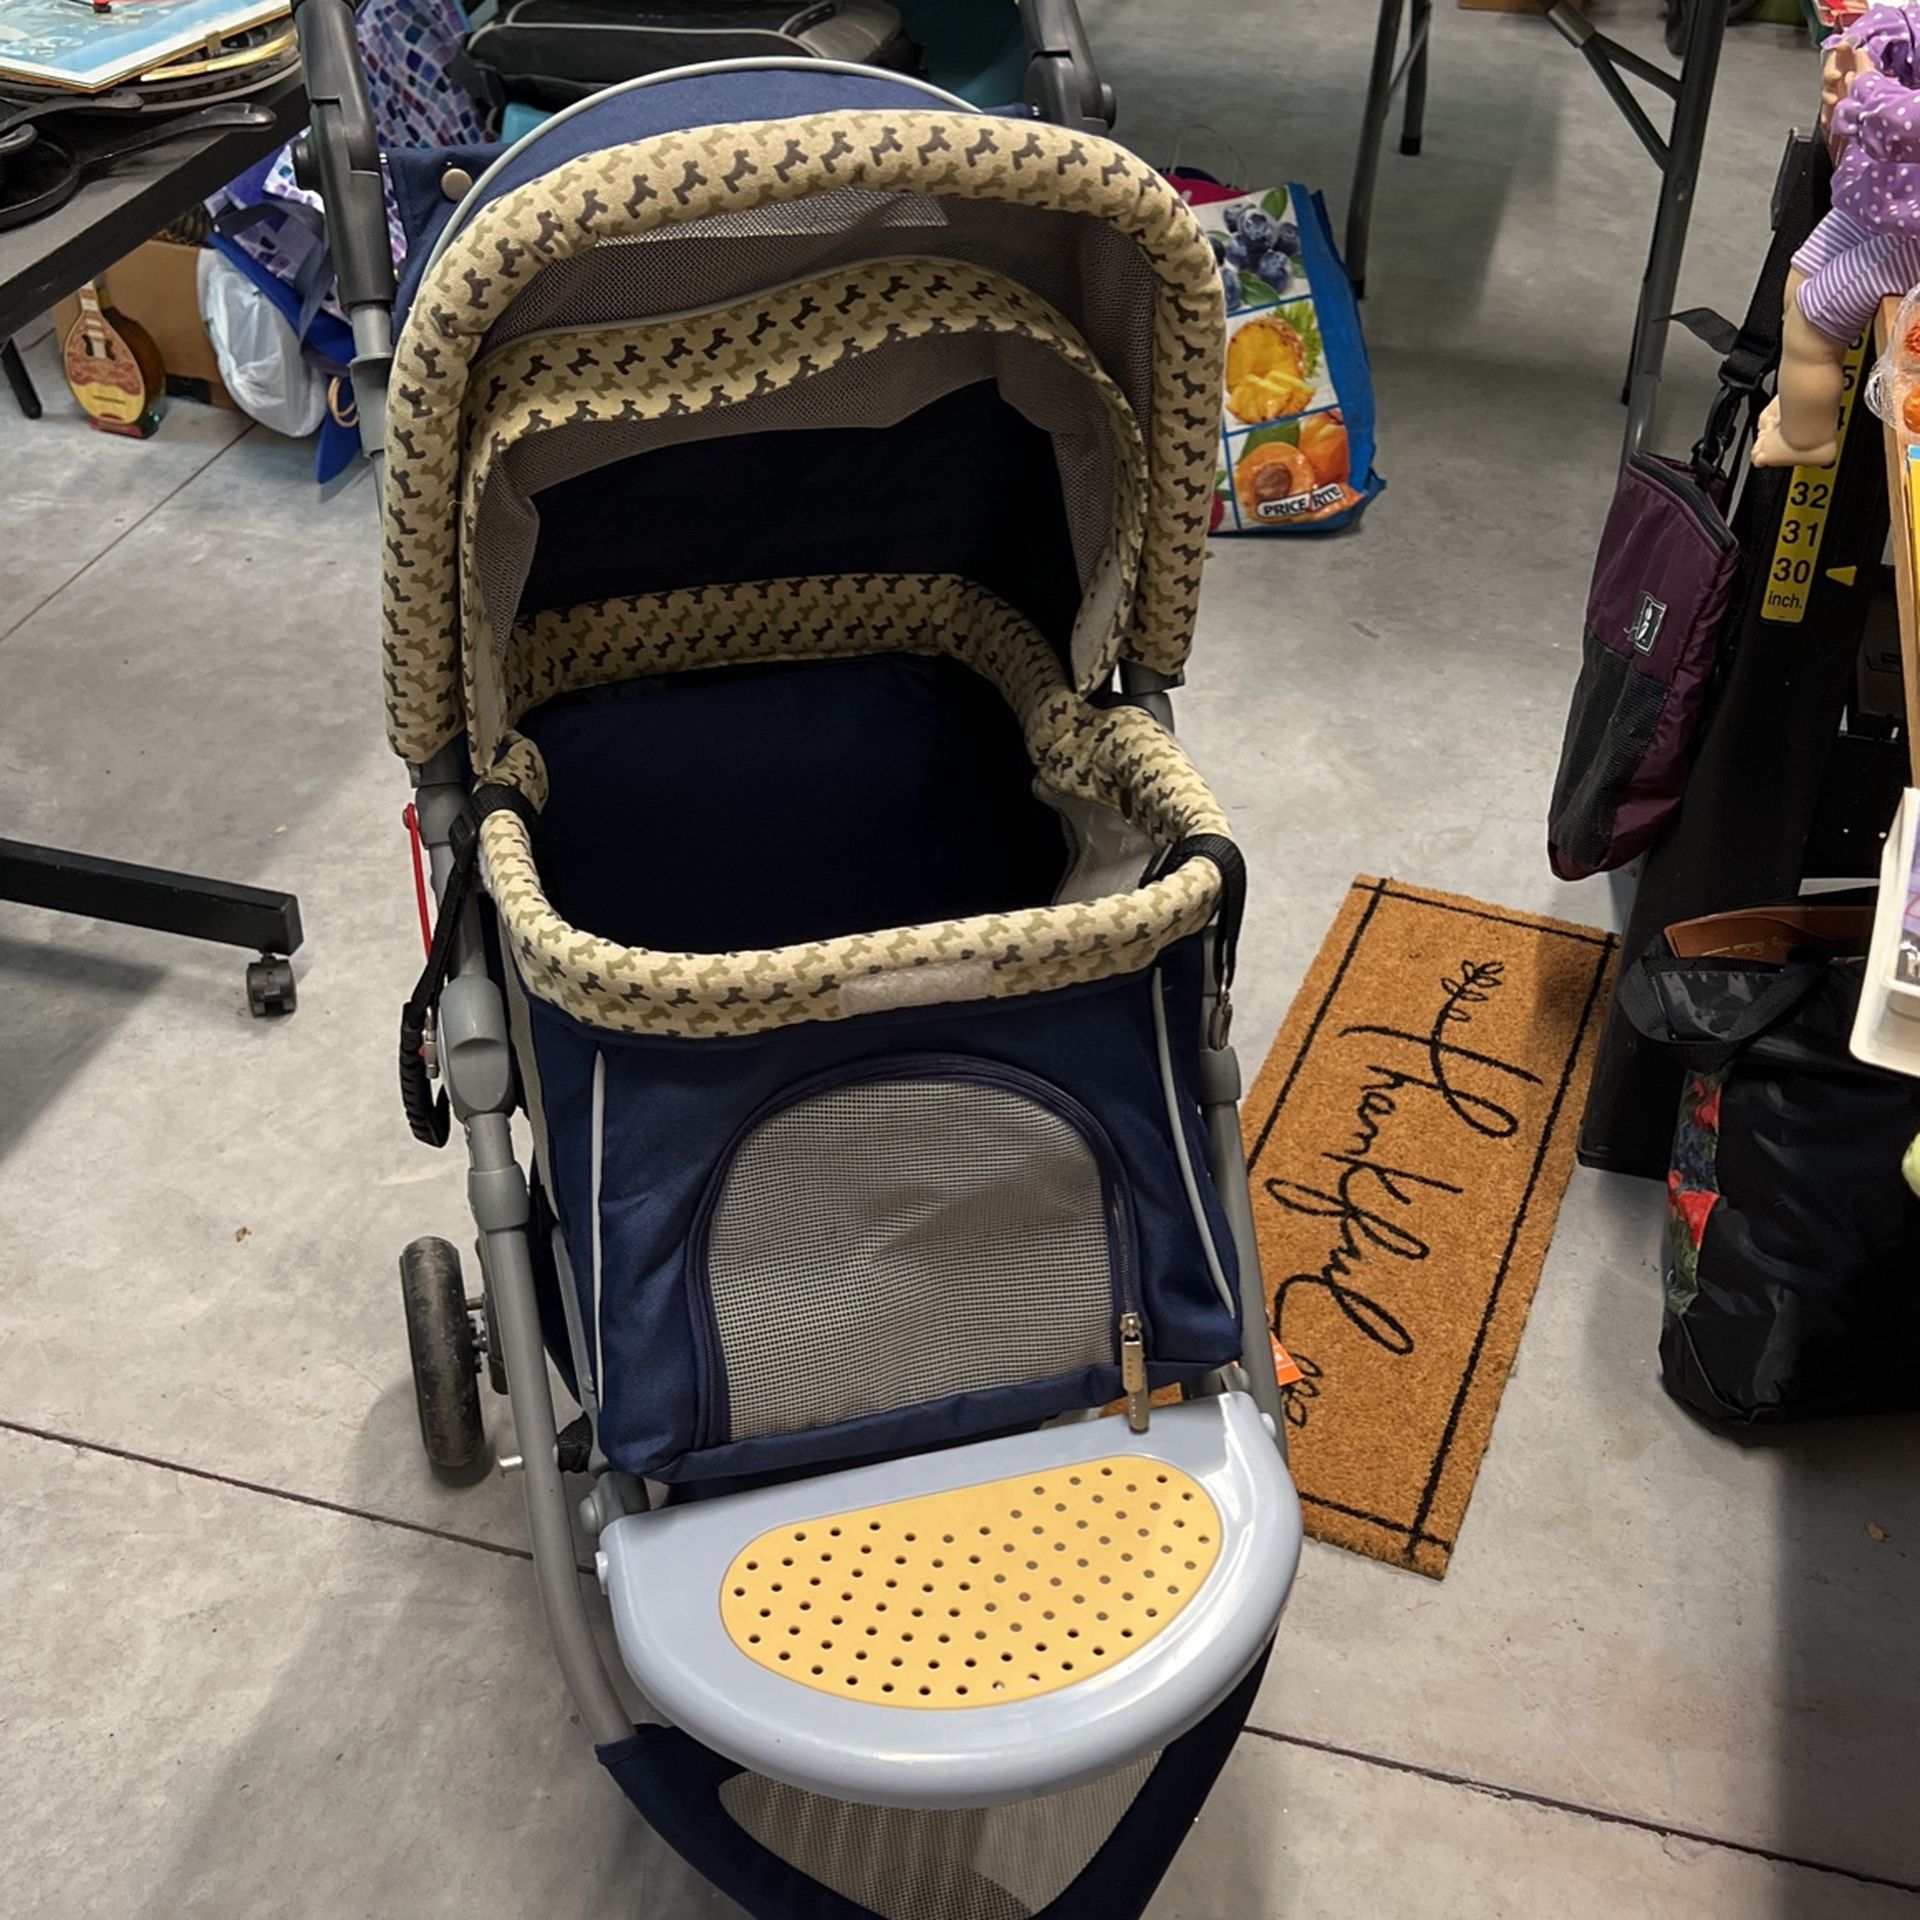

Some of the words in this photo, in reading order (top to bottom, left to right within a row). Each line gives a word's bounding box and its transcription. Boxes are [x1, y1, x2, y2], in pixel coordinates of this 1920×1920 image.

[1263, 498, 1307, 515] PRICE
[1790, 481, 1829, 509] 32
[1781, 520, 1819, 547] 31
[1772, 557, 1811, 584] 30
[1767, 590, 1803, 610] inch.
